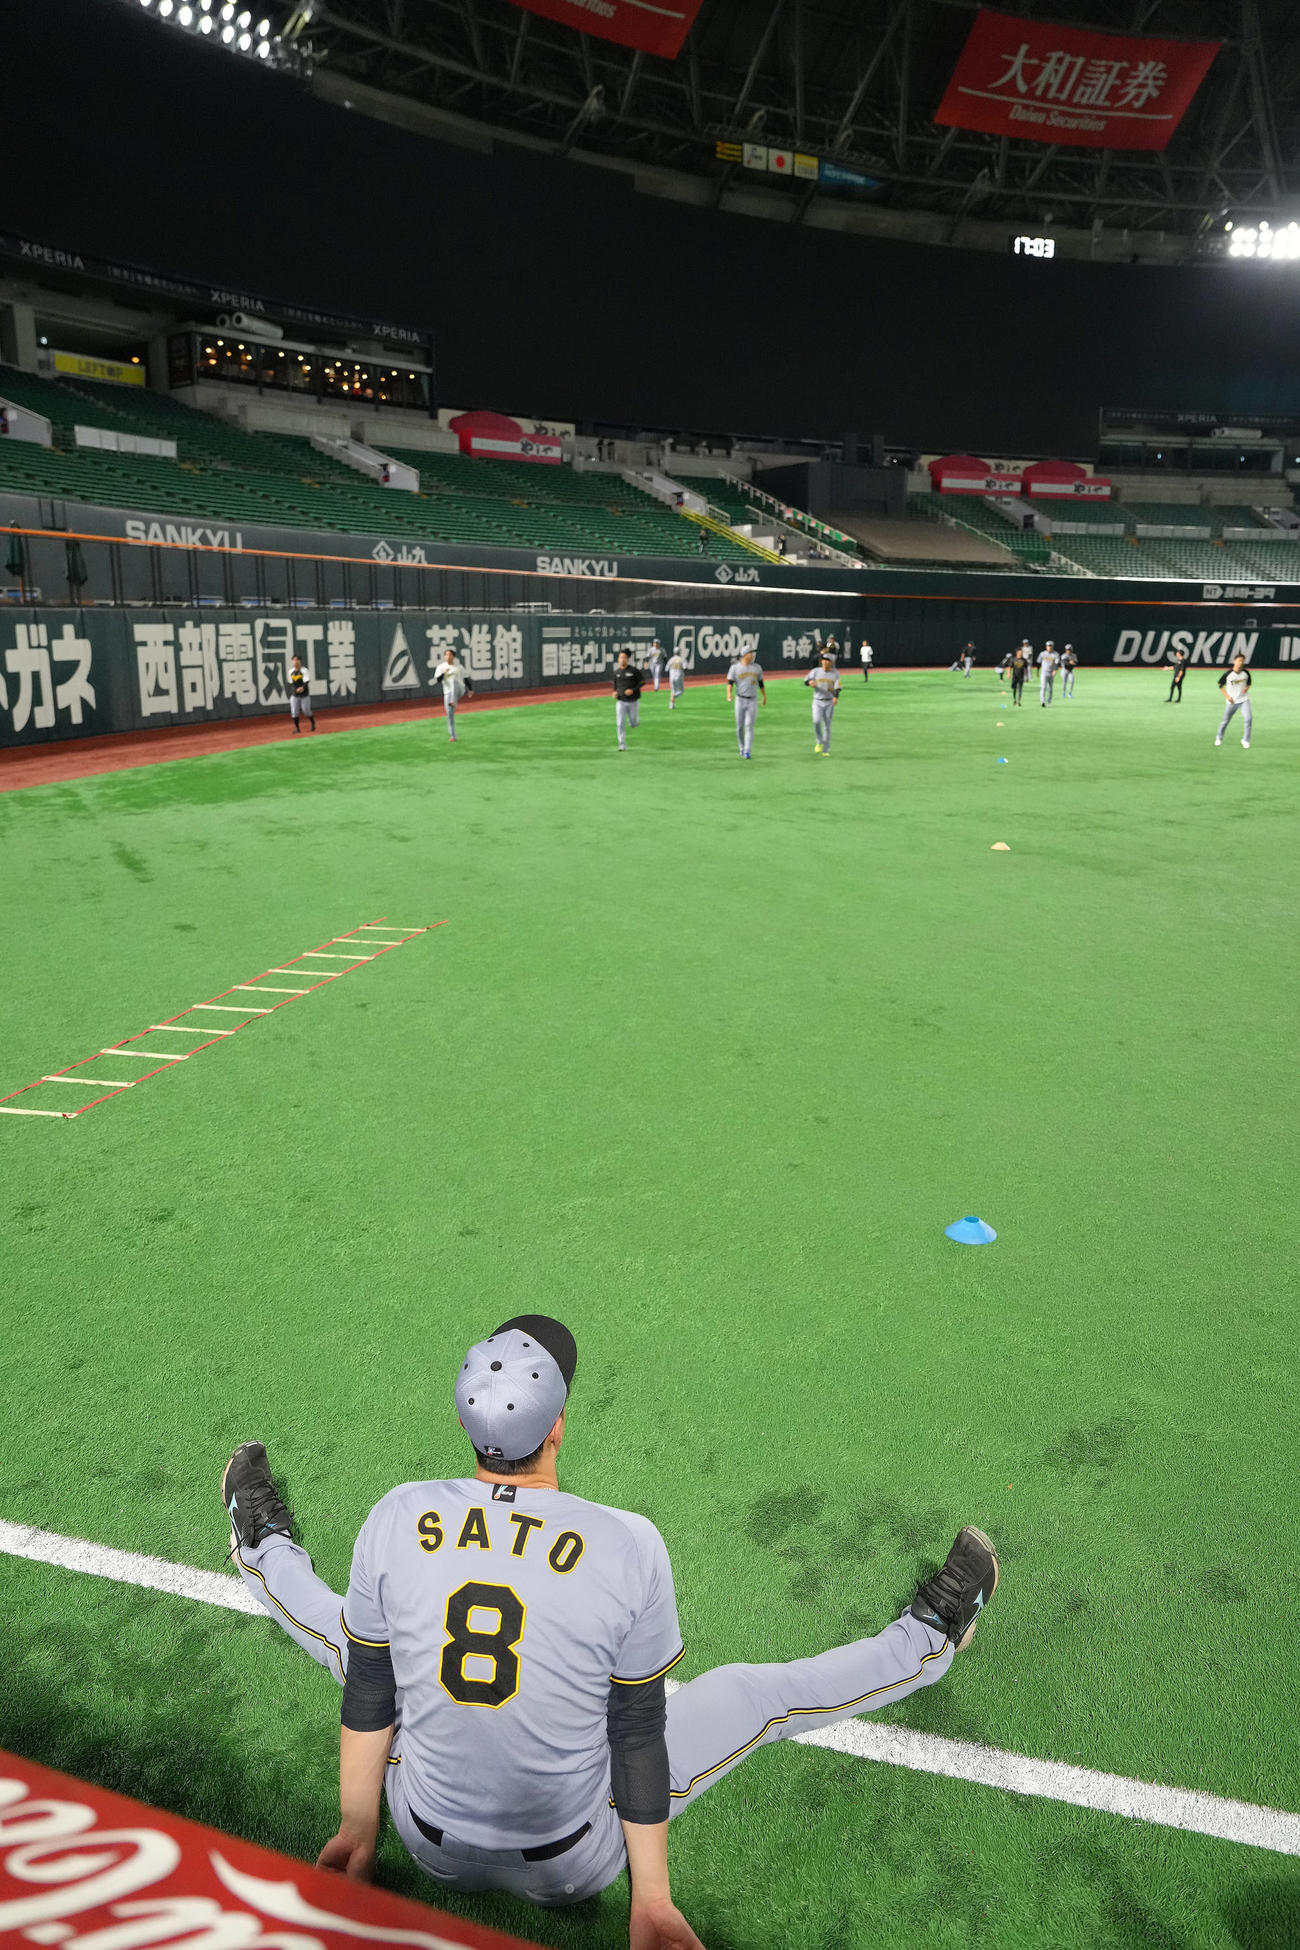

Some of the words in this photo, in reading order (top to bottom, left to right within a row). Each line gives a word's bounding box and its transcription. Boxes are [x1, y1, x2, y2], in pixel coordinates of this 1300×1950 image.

[988, 43, 1168, 109] 大和証券
[18, 240, 86, 271] XPERIA
[1014, 236, 1055, 258] 17:03
[209, 289, 265, 313] XPERIA
[372, 324, 421, 344] XPERIA
[1176, 413, 1218, 424] XPERIA
[125, 520, 243, 554] SANKYU
[536, 556, 618, 578] SANKYU
[735, 567, 761, 583] 山九
[426, 623, 524, 684] 英進館
[0, 624, 97, 733] ガネ
[416, 1506, 585, 1575] SATO
[437, 1580, 527, 1710] 8
